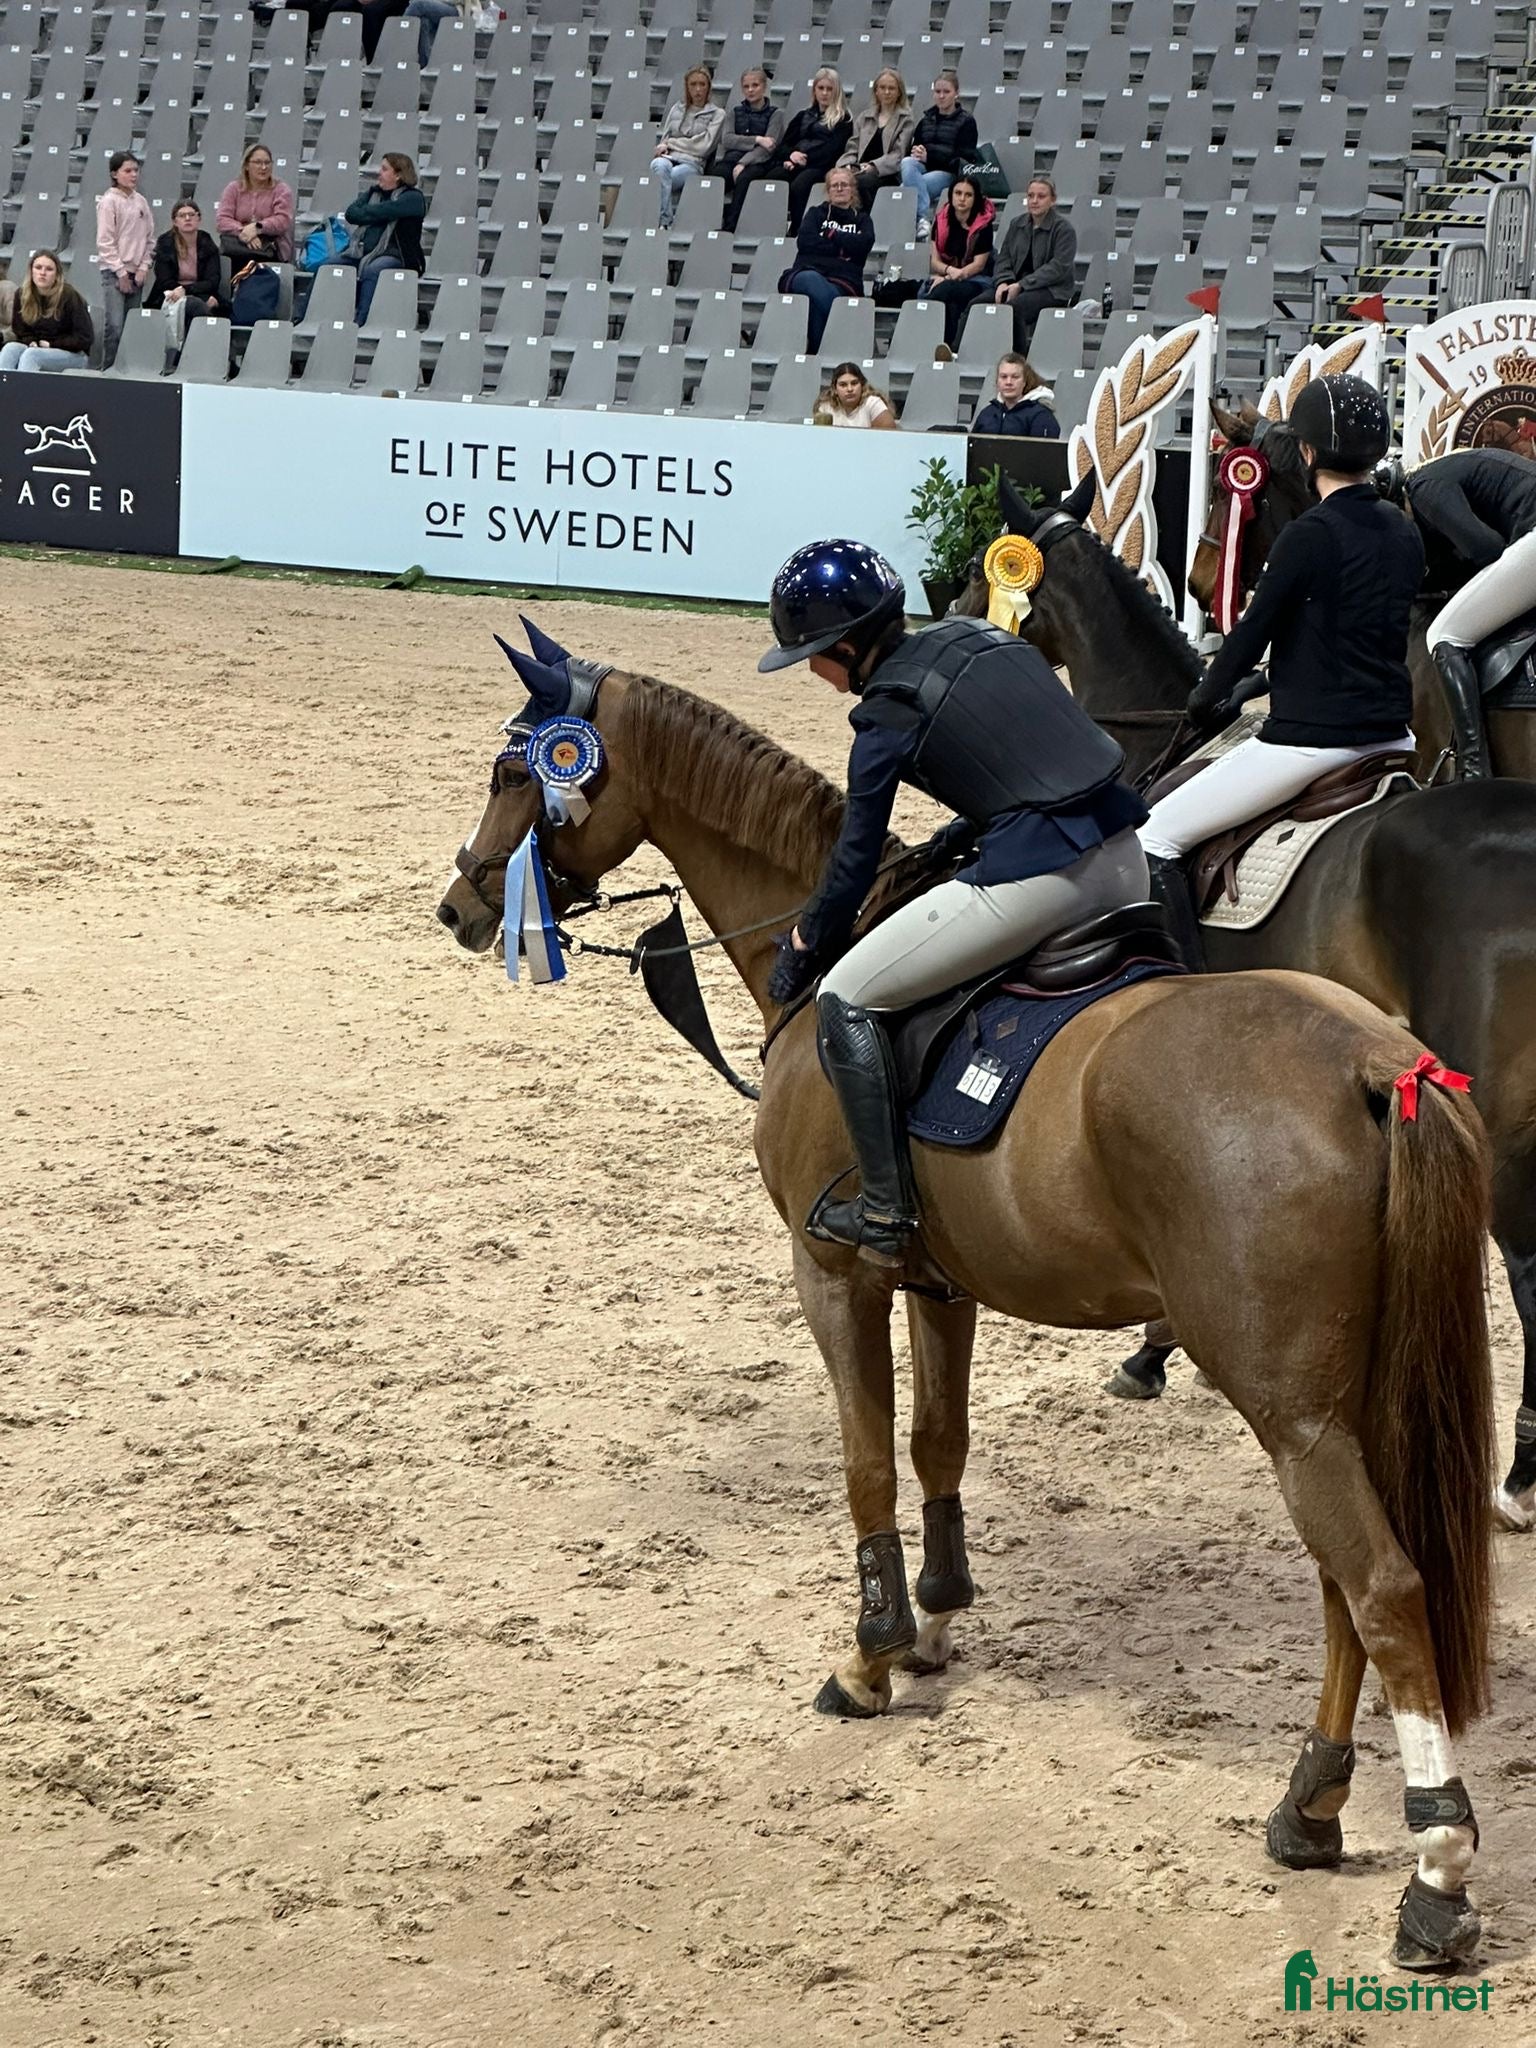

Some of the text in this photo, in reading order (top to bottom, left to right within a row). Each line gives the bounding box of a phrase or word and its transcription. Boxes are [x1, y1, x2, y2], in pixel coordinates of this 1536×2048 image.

[1468, 364, 1488, 388] 19
[1462, 389, 1536, 436] INTERNATIO
[390, 438, 733, 497] ELITE HOTELS
[0, 477, 135, 514] AGER
[425, 501, 694, 556] OF SWEDEN
